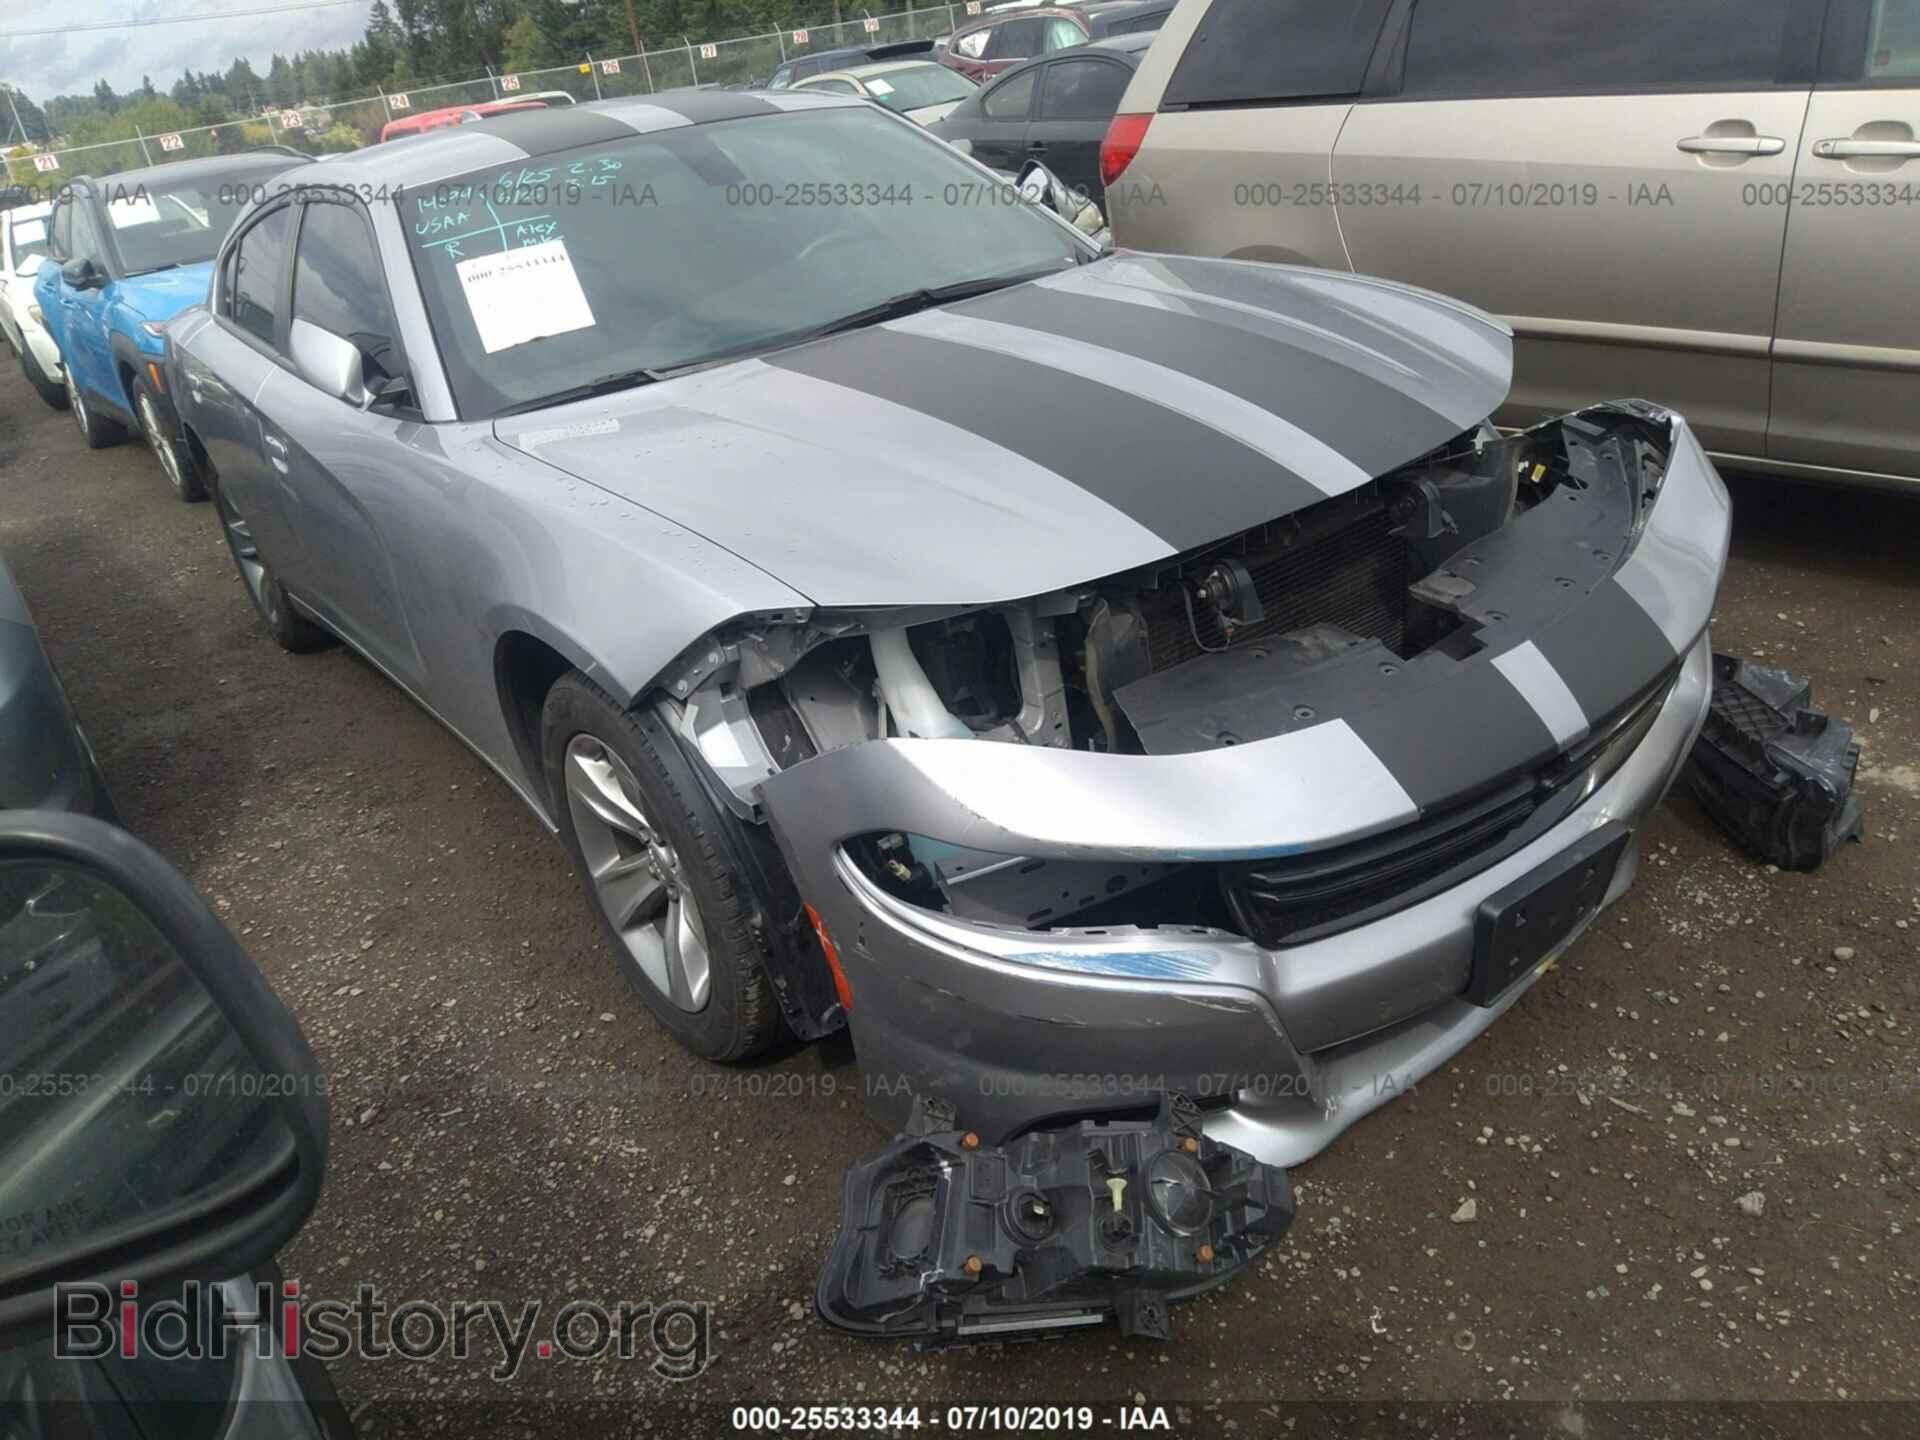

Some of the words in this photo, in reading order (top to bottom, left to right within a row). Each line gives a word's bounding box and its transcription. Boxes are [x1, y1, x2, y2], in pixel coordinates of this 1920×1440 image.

[703, 46, 717, 57] 27
[603, 61, 618, 72] 26
[502, 76, 517, 89] 25
[391, 95, 407, 108] 24
[284, 112, 300, 126] 23
[163, 135, 180, 148] 22
[39, 155, 55, 168] 21
[415, 211, 471, 234] USAA
